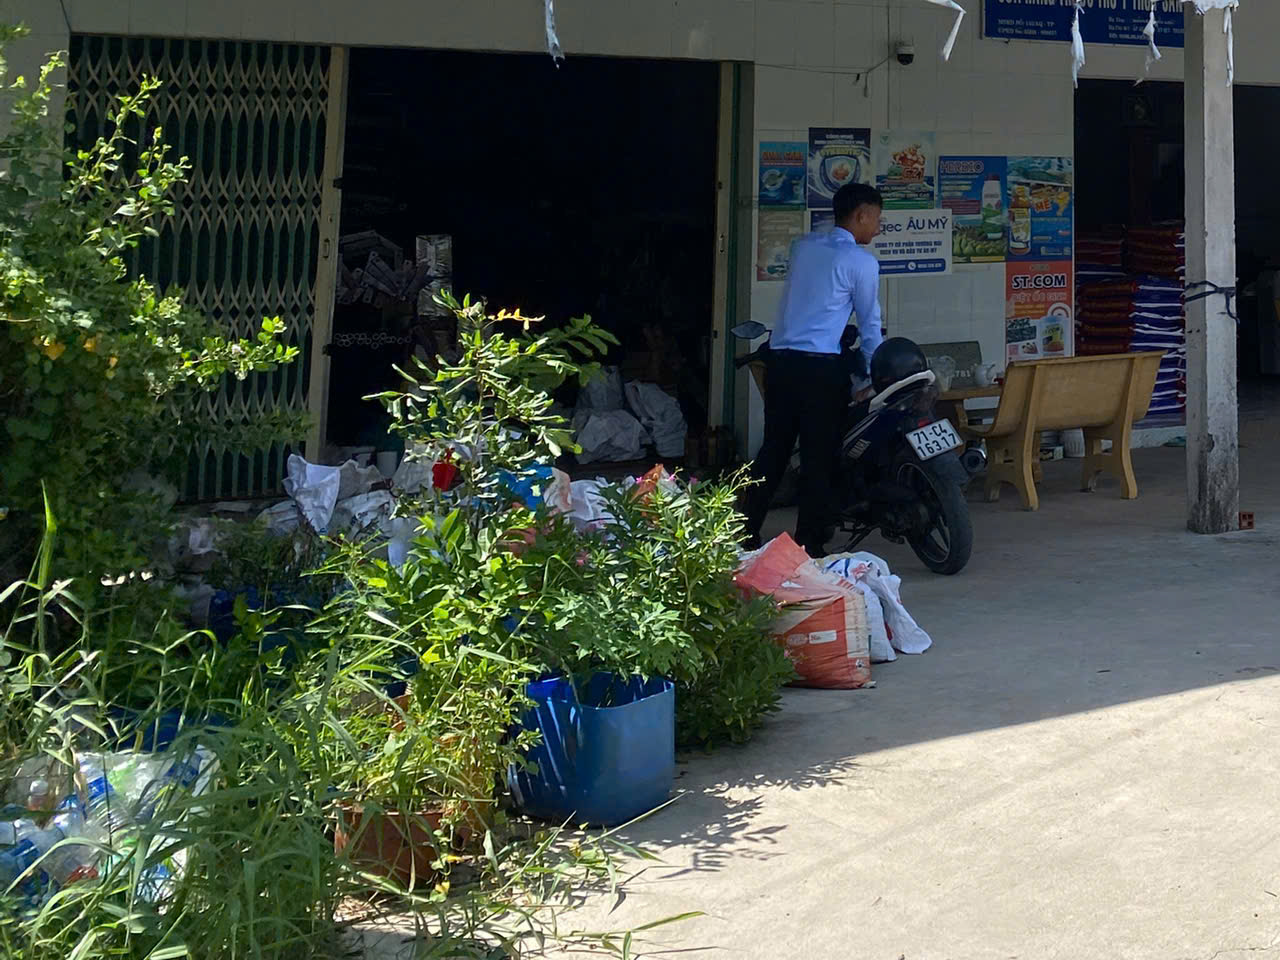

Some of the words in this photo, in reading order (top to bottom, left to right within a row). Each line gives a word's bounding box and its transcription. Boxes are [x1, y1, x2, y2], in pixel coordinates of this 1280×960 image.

[906, 216, 926, 231] ÂU
[1011, 273, 1067, 289] ST.COM
[912, 423, 949, 444] 71-C4
